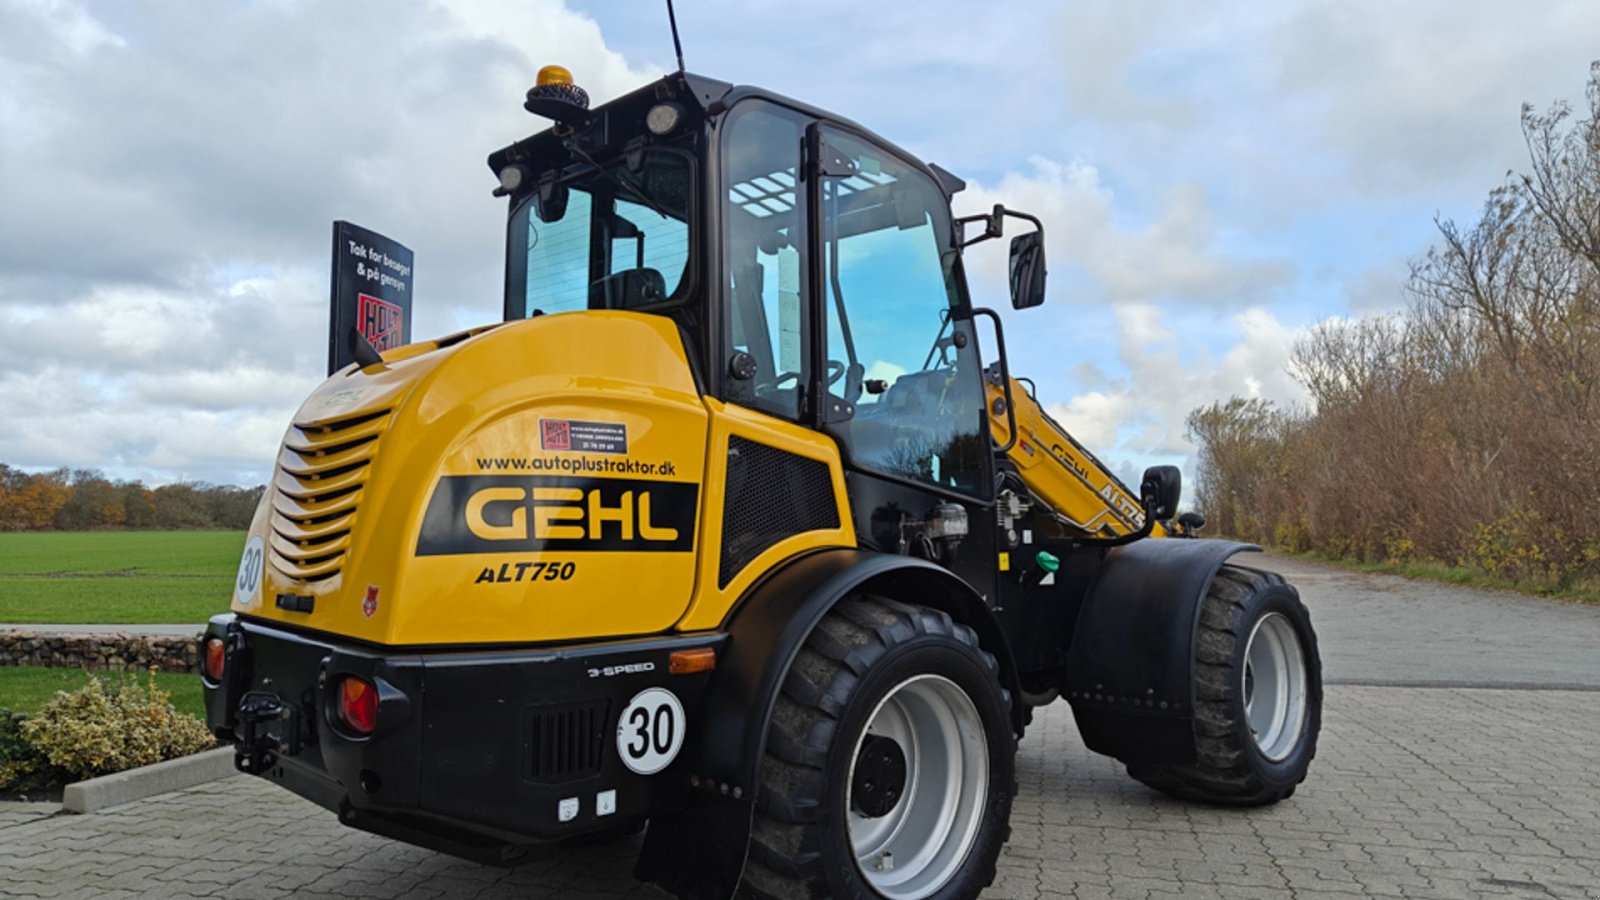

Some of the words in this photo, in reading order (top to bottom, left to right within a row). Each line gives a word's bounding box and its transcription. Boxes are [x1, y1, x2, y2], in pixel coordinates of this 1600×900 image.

[348, 240, 367, 258] Tak
[368, 248, 382, 263] for
[357, 262, 366, 276] &
[367, 268, 379, 281] på
[477, 457, 675, 476] www.autoplustraktor.dk
[465, 488, 678, 540] GEHL
[240, 548, 261, 591] 30
[475, 562, 575, 584] ALT750
[588, 662, 655, 678] 3-SPEED
[628, 704, 674, 759] 30
